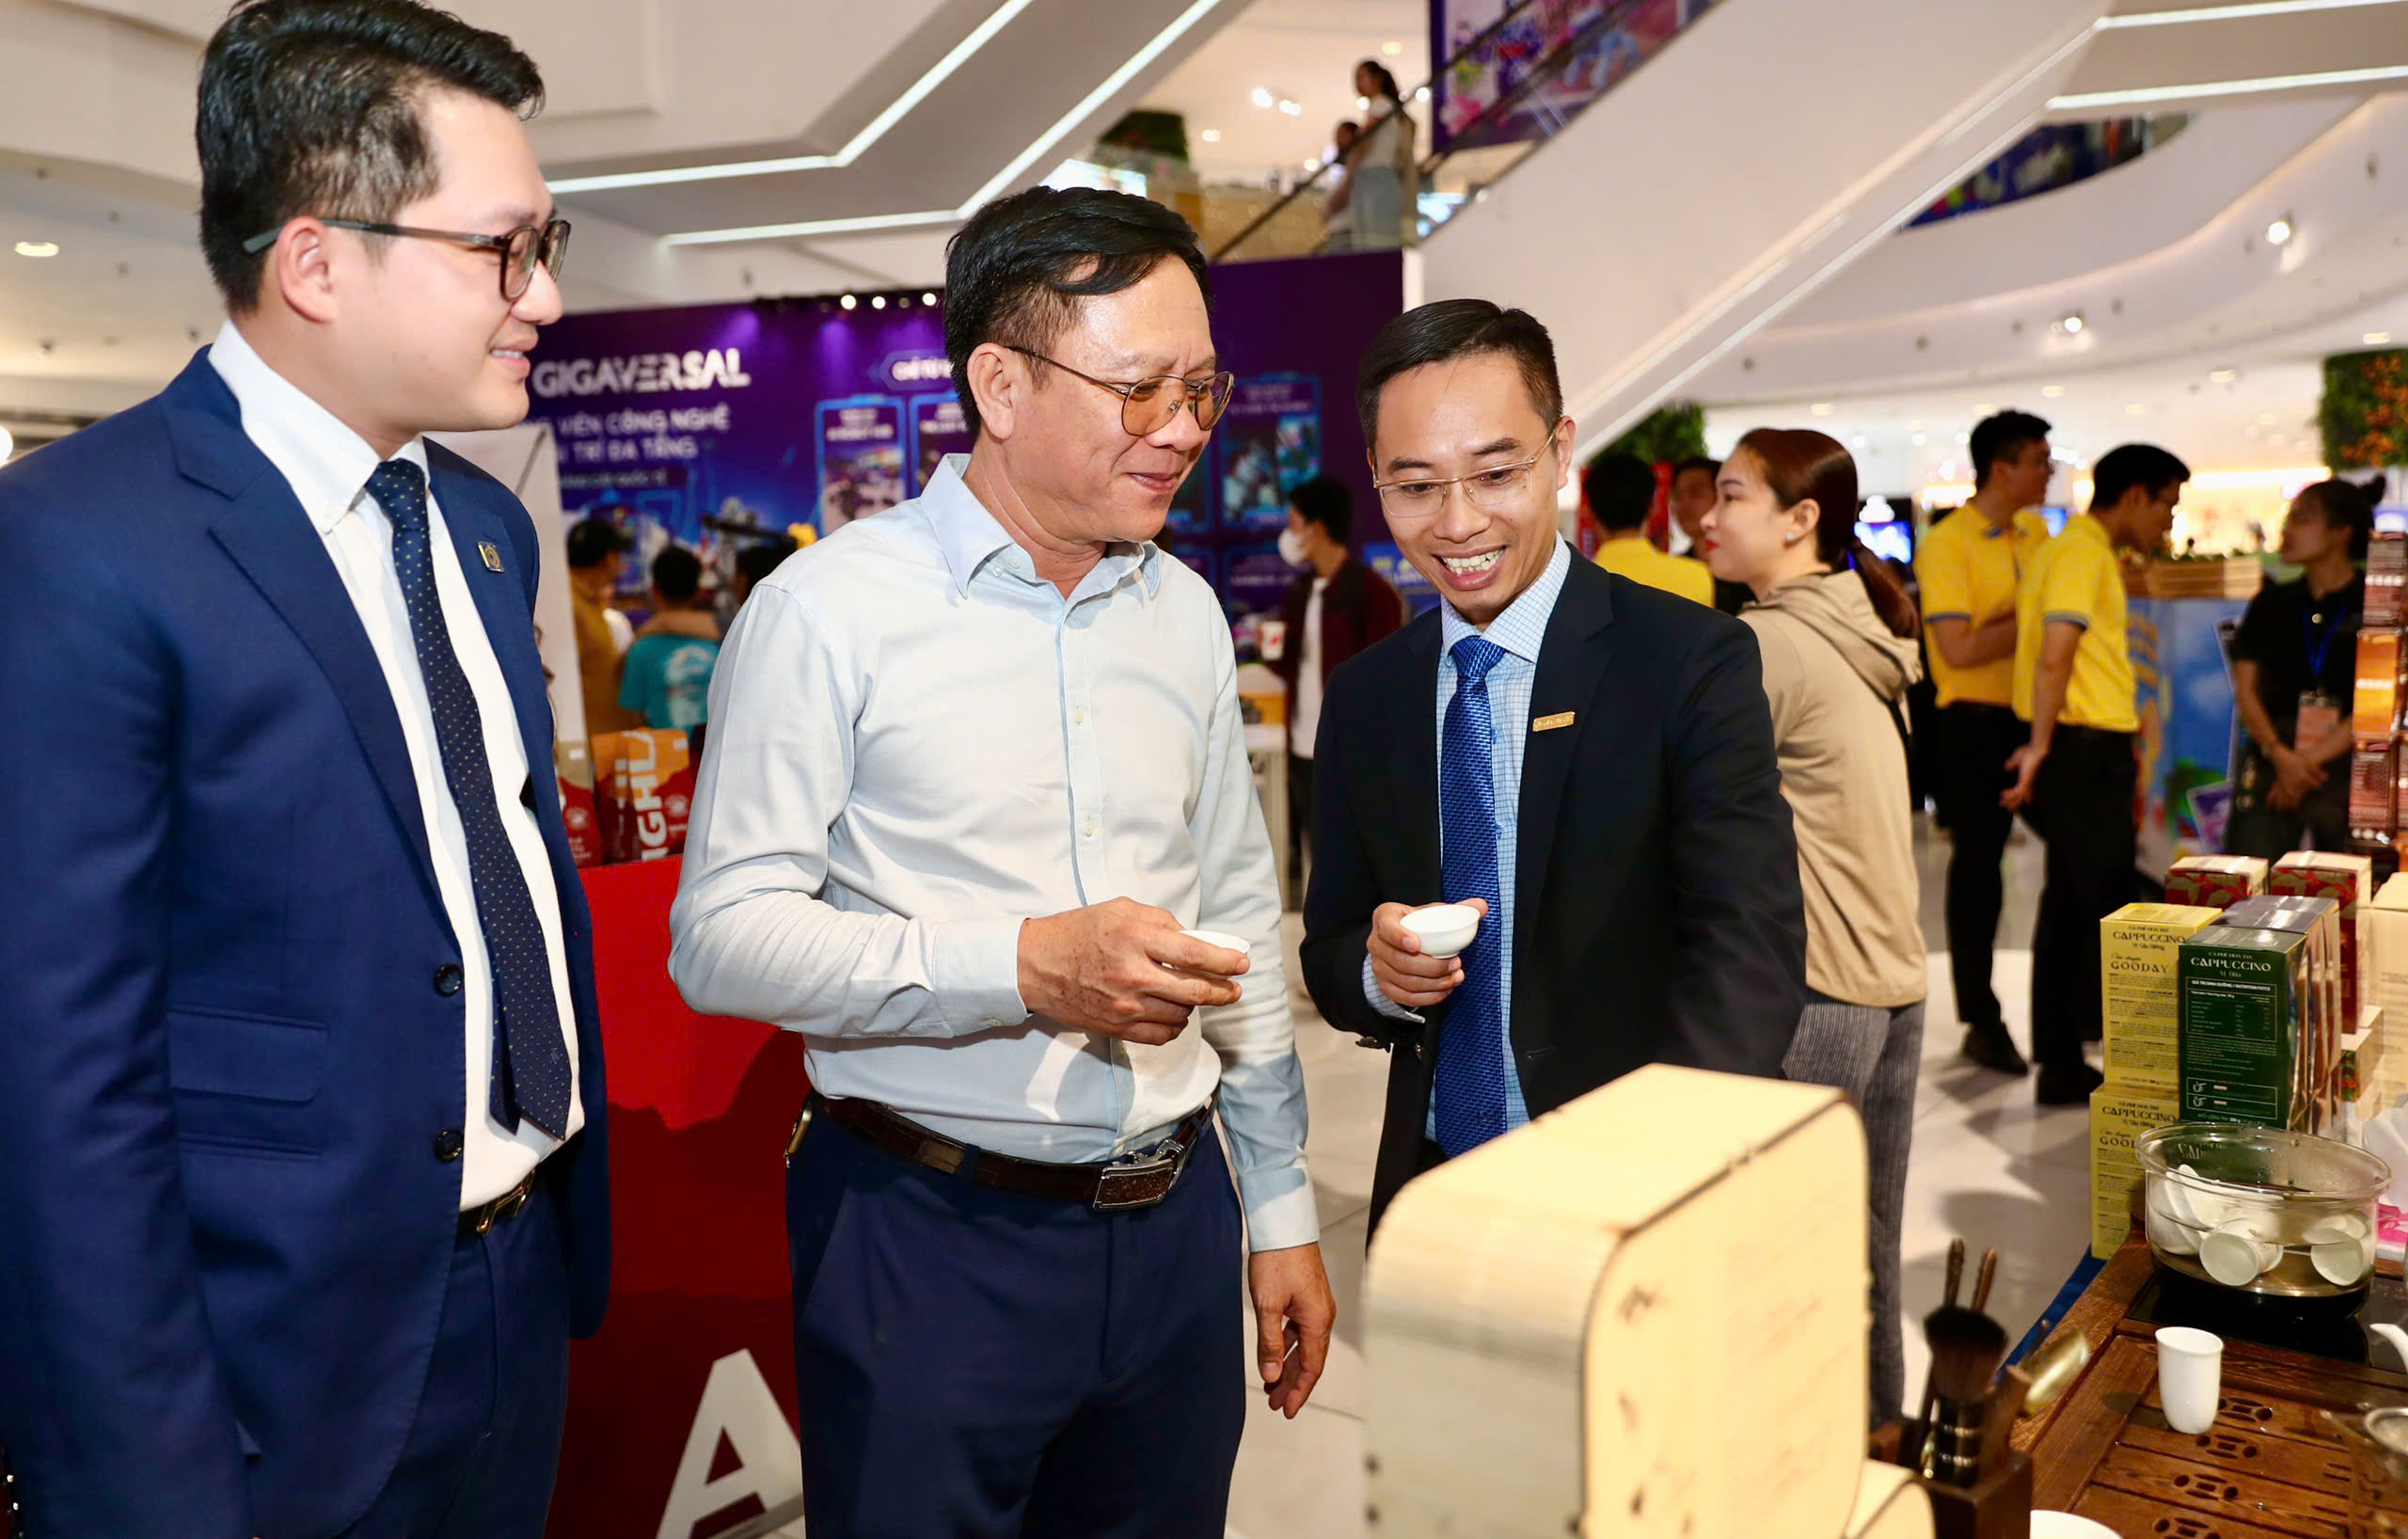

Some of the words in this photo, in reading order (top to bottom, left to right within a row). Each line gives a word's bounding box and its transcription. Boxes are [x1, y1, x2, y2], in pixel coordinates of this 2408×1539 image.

[531, 348, 752, 398] GIGAVERSAL
[2111, 960, 2168, 974] GOODAY
[2191, 957, 2272, 972] CAPPUCCINO
[2101, 1105, 2176, 1123] CAPPUCCINO
